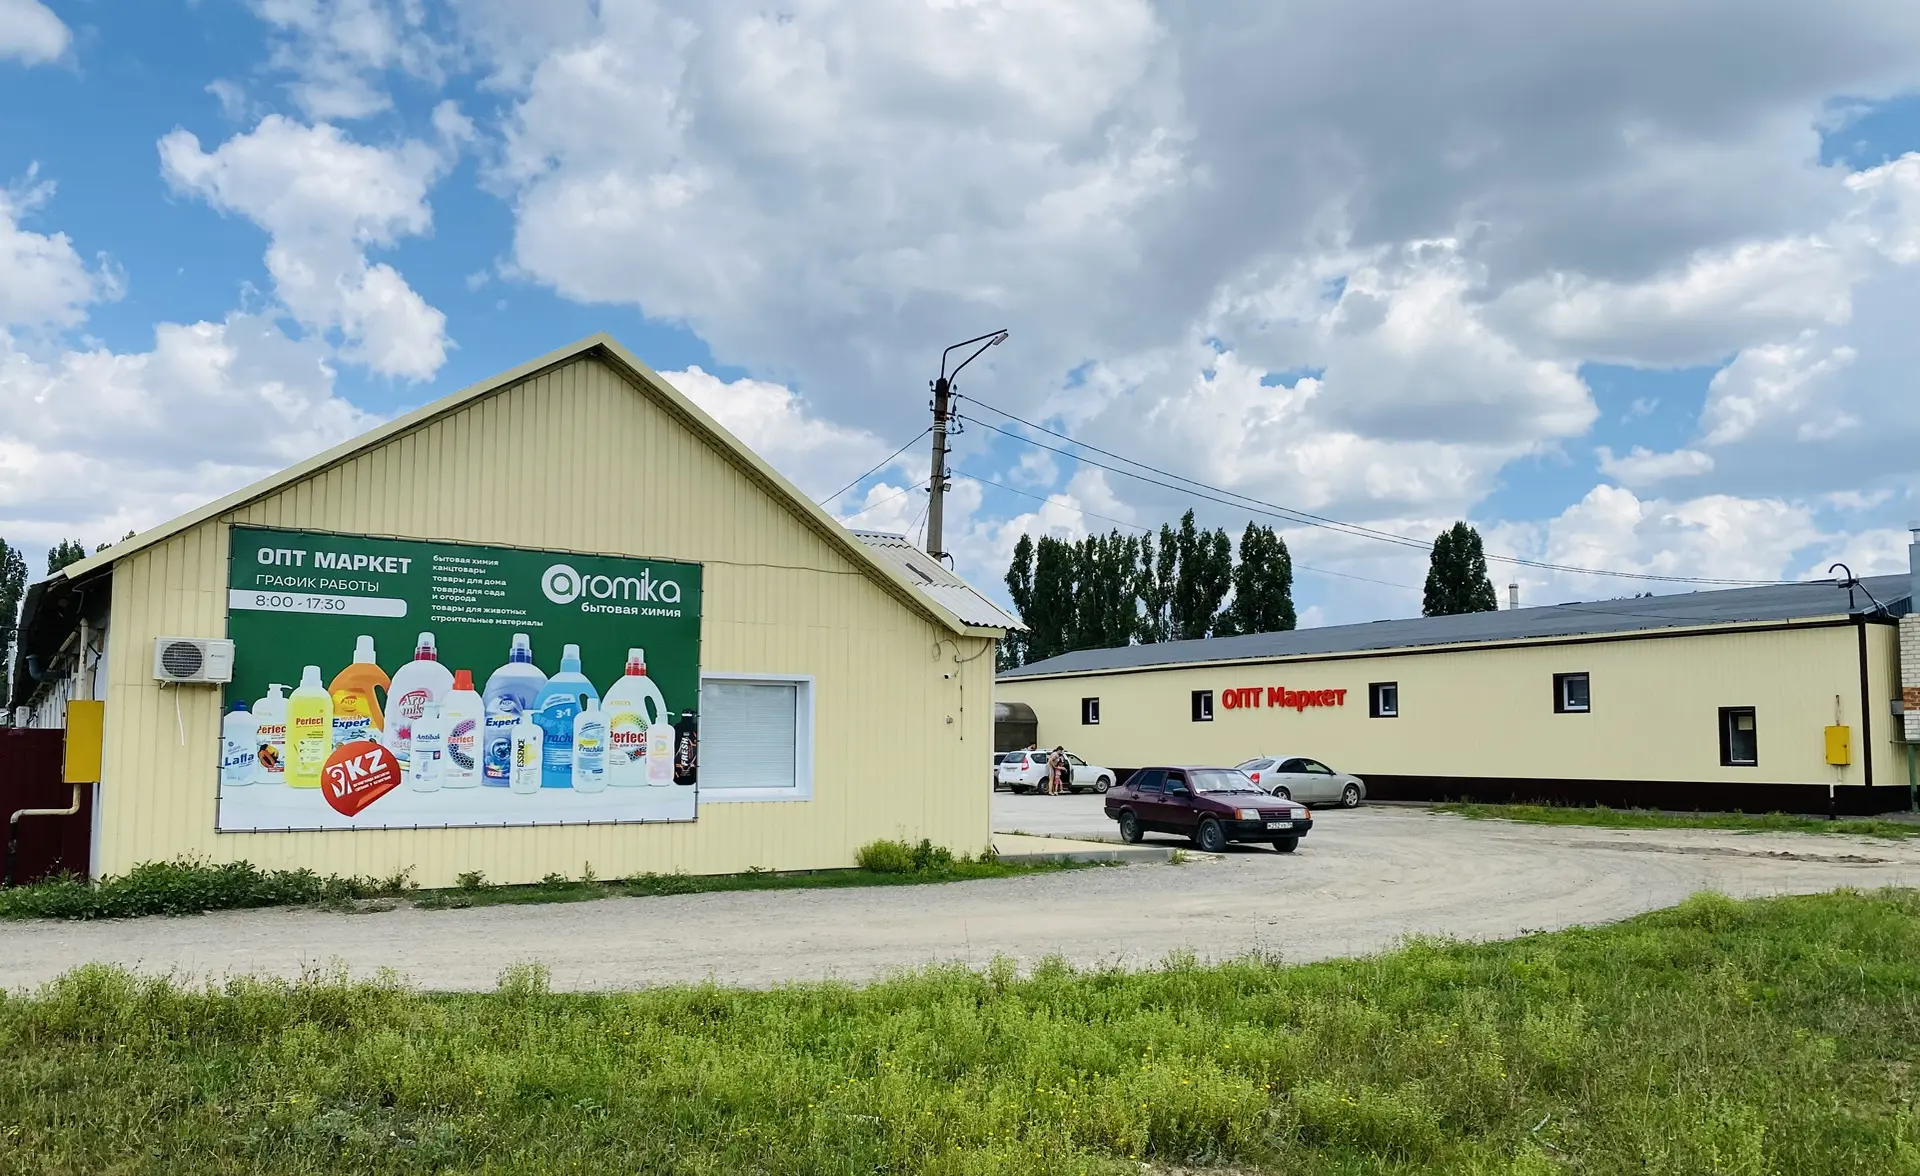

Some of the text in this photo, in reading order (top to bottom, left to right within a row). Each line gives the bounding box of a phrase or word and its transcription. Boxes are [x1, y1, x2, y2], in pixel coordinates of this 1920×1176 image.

[257, 547, 412, 574] ОПТ МАРКЕТ
[433, 555, 499, 566] бытовая химия
[432, 565, 486, 574] канцтовары
[256, 574, 379, 592] ГРАФИК РАБОТЫ
[432, 576, 466, 584] товары
[432, 586, 466, 595] товары
[484, 589, 506, 597] сада
[255, 594, 294, 608] 8:00
[306, 597, 346, 611] 17:30
[440, 595, 477, 603] огорода
[431, 605, 527, 616] товары для животных
[581, 602, 681, 618] бытовая химия
[430, 615, 544, 627] строительные материалы
[1222, 687, 1347, 712] ОПТ Маркет
[295, 717, 324, 726] Perfect
[332, 718, 371, 729] Expert
[485, 717, 521, 728] Expert
[256, 725, 287, 734] erfec
[447, 735, 474, 744] Perfect
[543, 729, 573, 743] Prach
